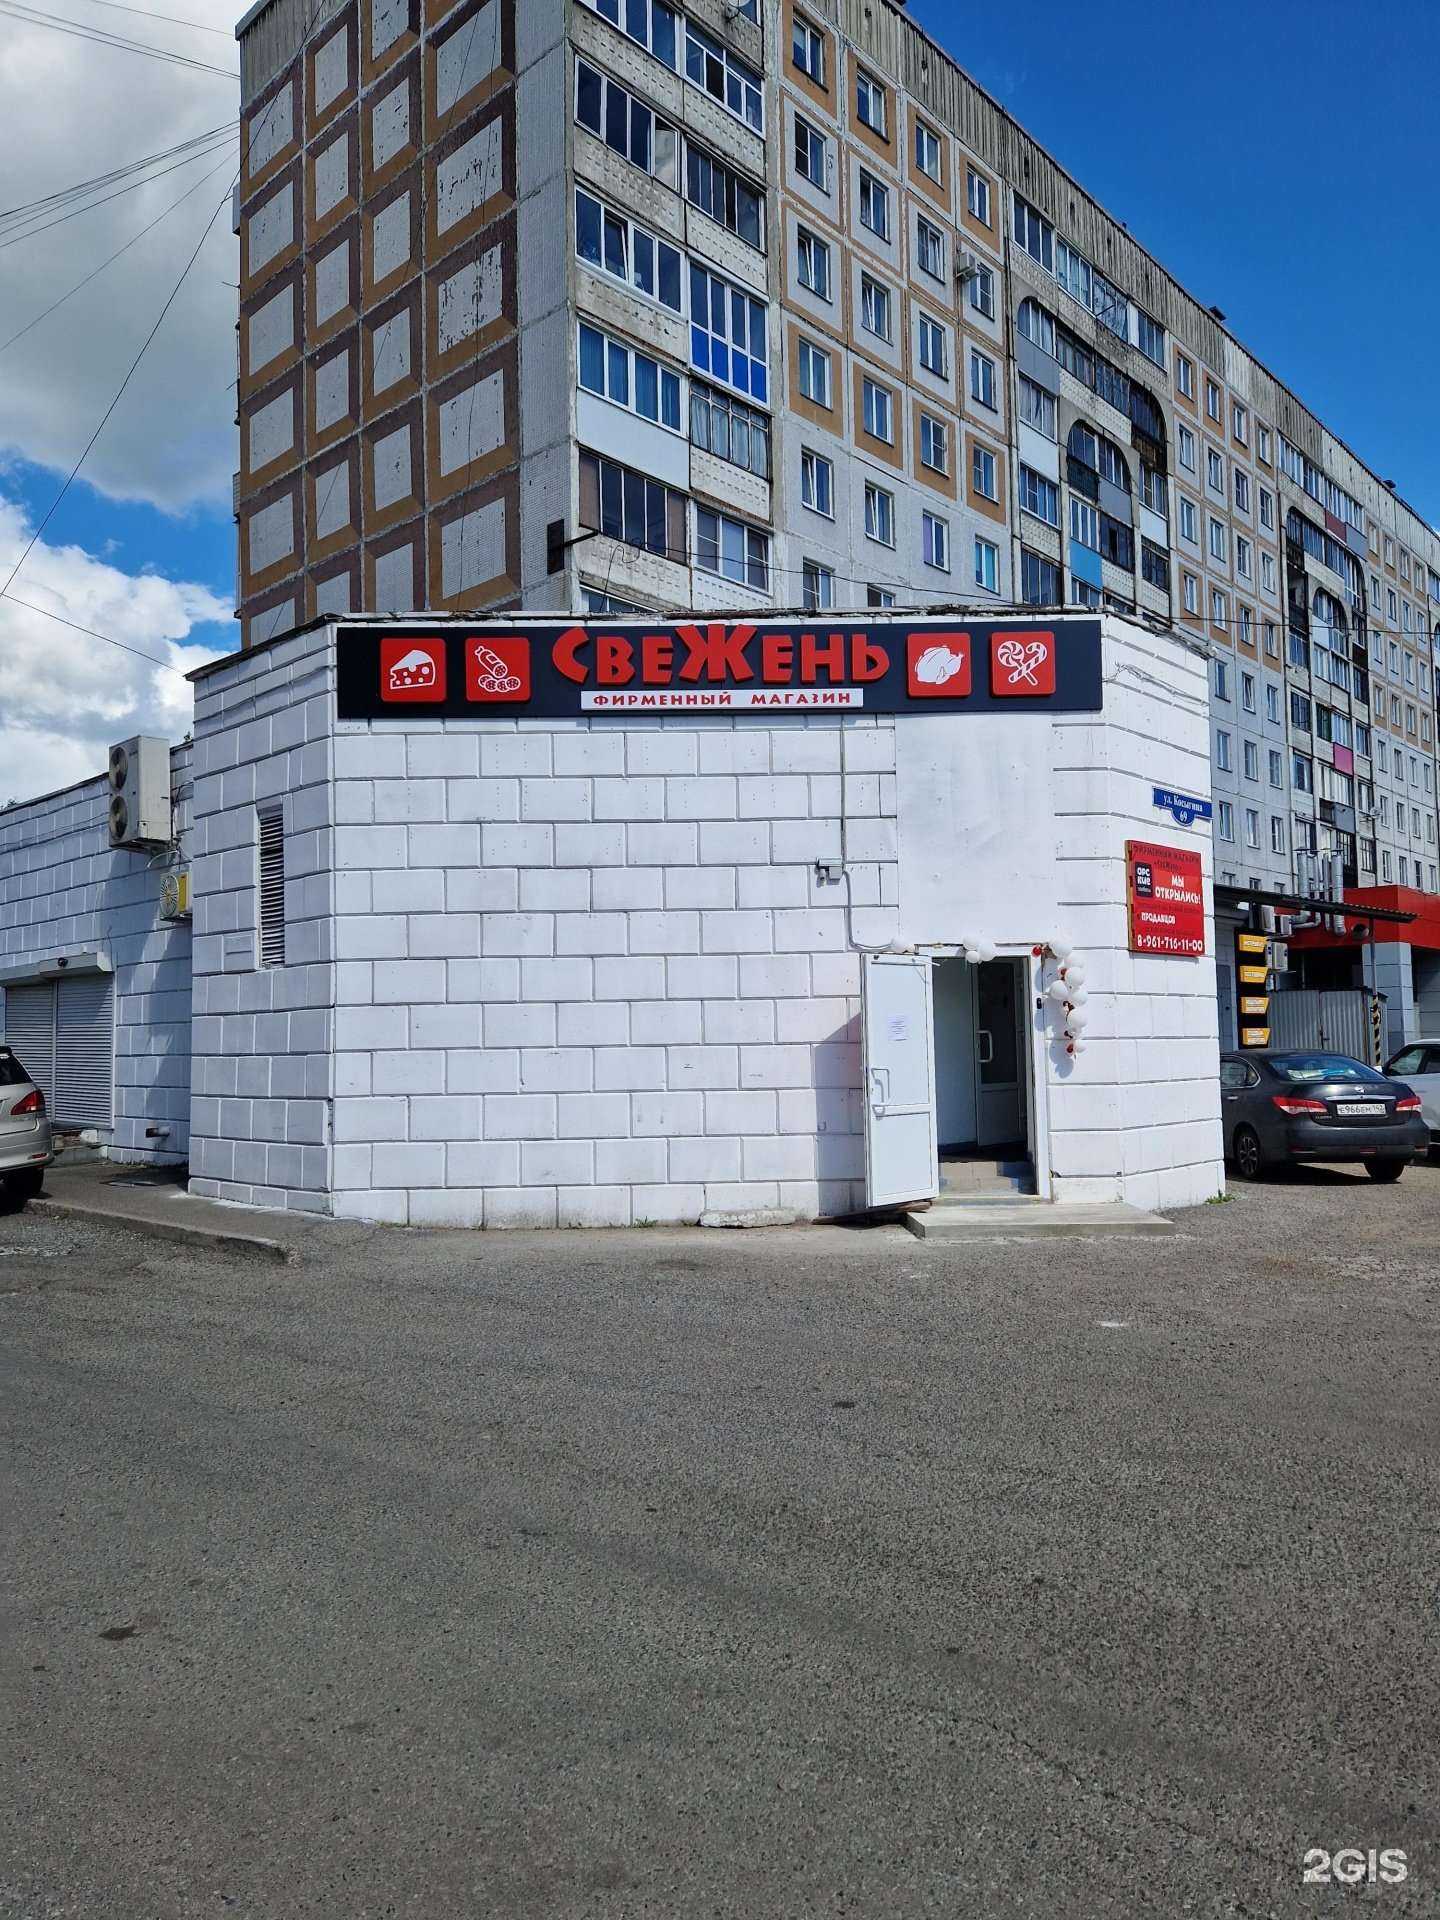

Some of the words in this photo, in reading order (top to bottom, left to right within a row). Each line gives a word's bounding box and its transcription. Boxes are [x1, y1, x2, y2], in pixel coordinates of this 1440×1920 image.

[593, 692, 732, 706] ФИРМЕННЫЙ
[751, 693, 851, 705] МАГАЗИН
[1163, 794, 1173, 805] ул.
[1173, 795, 1203, 812] Косыгина
[1179, 810, 1188, 822] 69
[1171, 875, 1184, 887] МЫ
[1155, 886, 1201, 904] ОТКРЫЛИСЬ!
[1141, 912, 1176, 924] ПРОДАВЦОВ
[1137, 934, 1203, 951] 8-961-716-11-00
